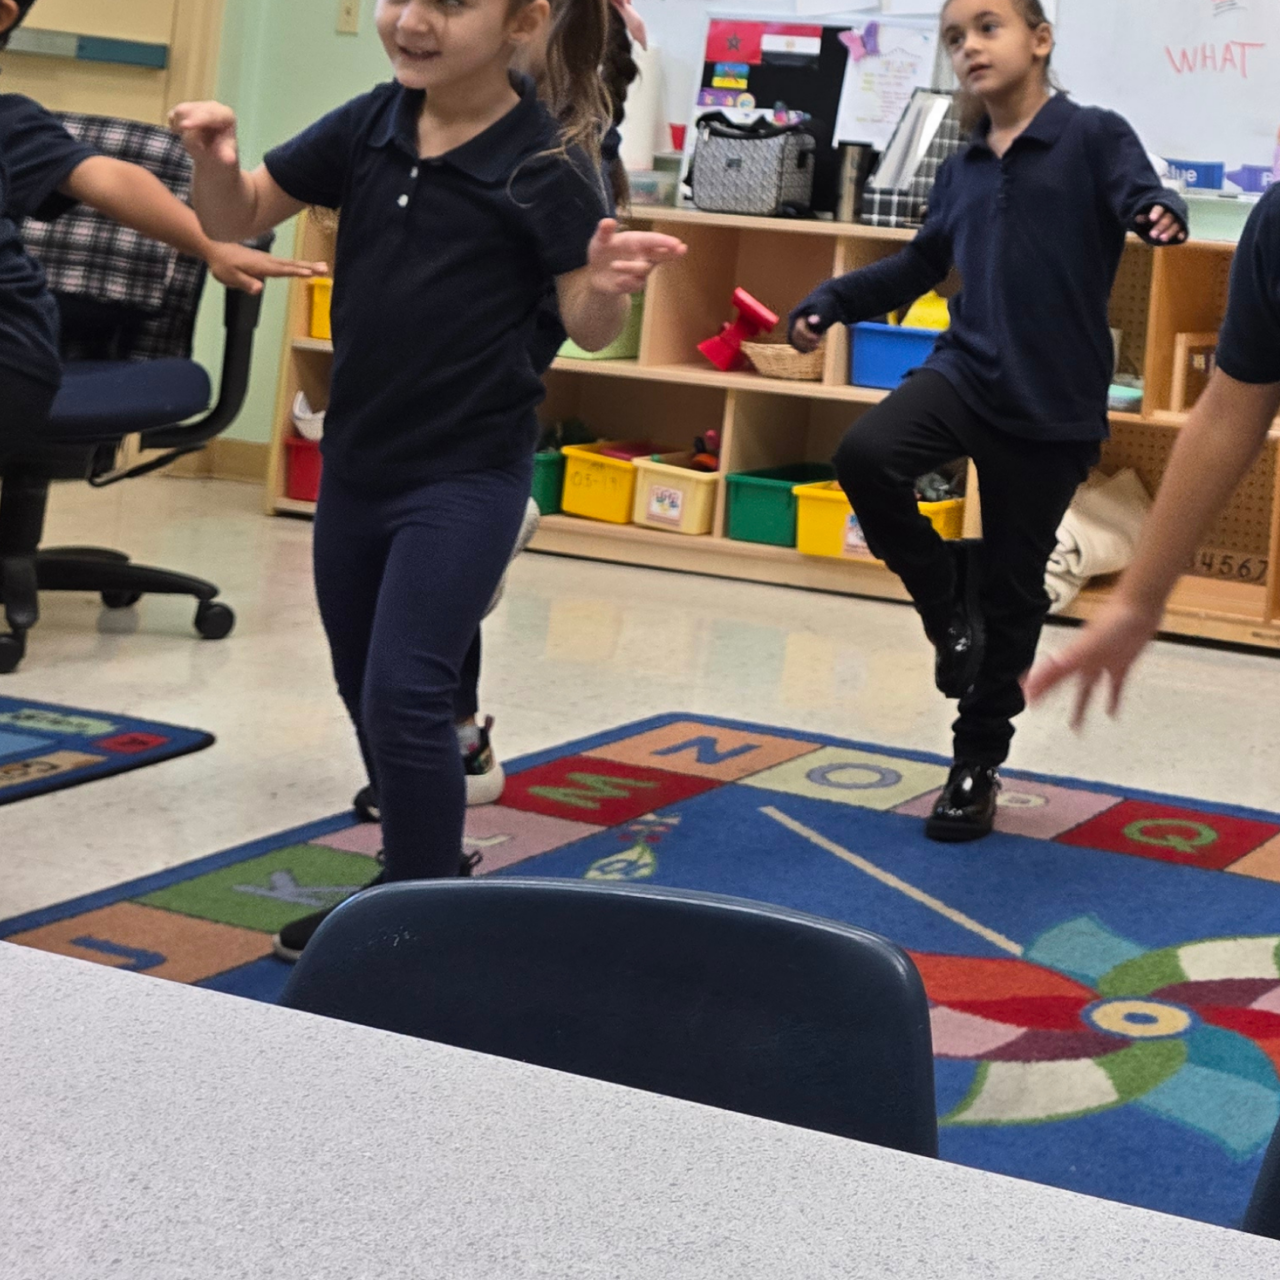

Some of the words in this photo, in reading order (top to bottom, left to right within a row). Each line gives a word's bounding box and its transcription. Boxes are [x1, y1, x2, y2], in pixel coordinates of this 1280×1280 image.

[1164, 39, 1267, 79] WHAT
[1170, 165, 1198, 182] lue
[652, 736, 761, 765] N
[804, 762, 903, 790] O
[1122, 818, 1219, 854] Q
